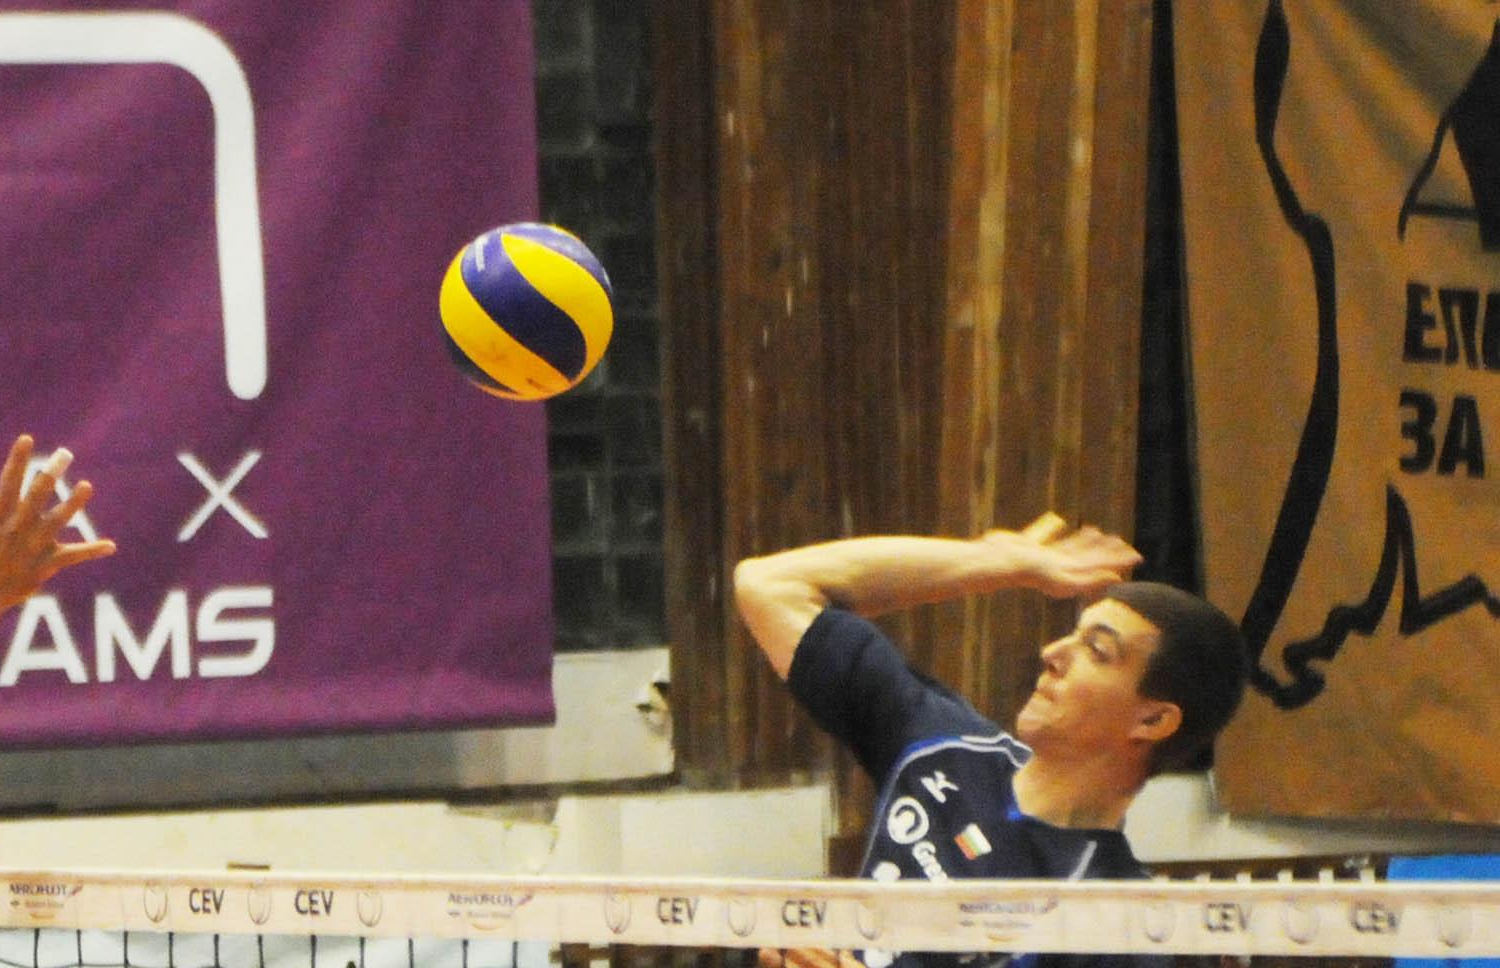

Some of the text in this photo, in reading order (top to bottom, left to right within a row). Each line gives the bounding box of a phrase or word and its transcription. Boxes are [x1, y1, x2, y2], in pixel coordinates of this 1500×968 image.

[189, 887, 226, 914] CEV
[294, 890, 334, 916] CEV
[656, 897, 699, 925] CEV
[781, 899, 828, 927] CEV
